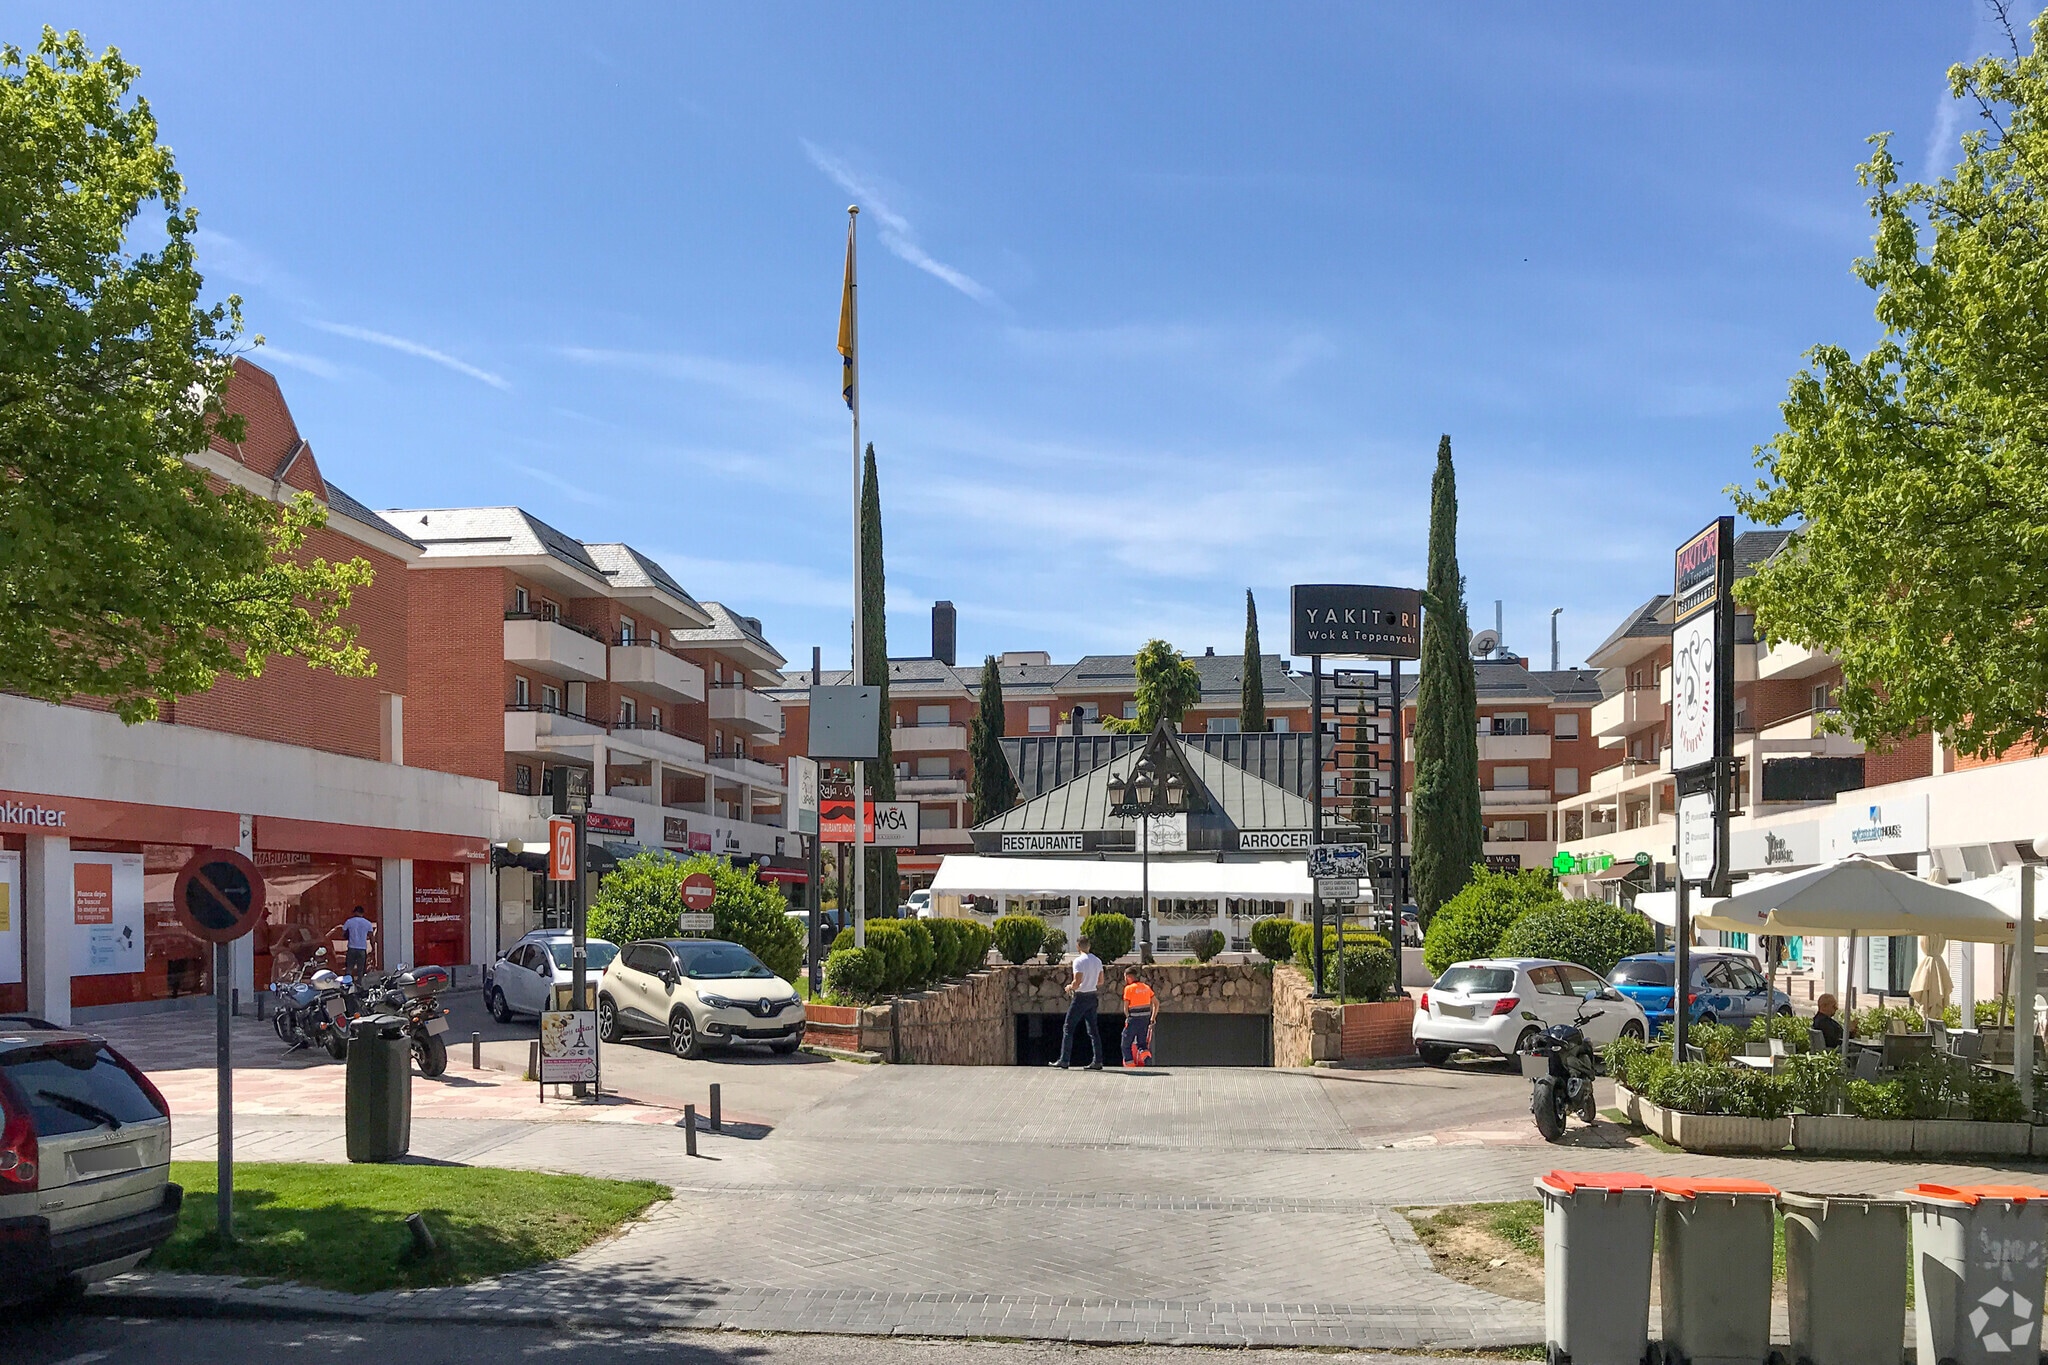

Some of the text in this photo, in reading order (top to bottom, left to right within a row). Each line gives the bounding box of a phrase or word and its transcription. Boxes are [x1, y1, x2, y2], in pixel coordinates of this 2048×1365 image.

[1308, 629, 1416, 644] Wok & Teppanyaki
[1003, 836, 1082, 850] RESTAURANTE
[1241, 833, 1312, 848] ARROCERI
[1495, 855, 1516, 863] Wok
[1636, 854, 1648, 863] dp
